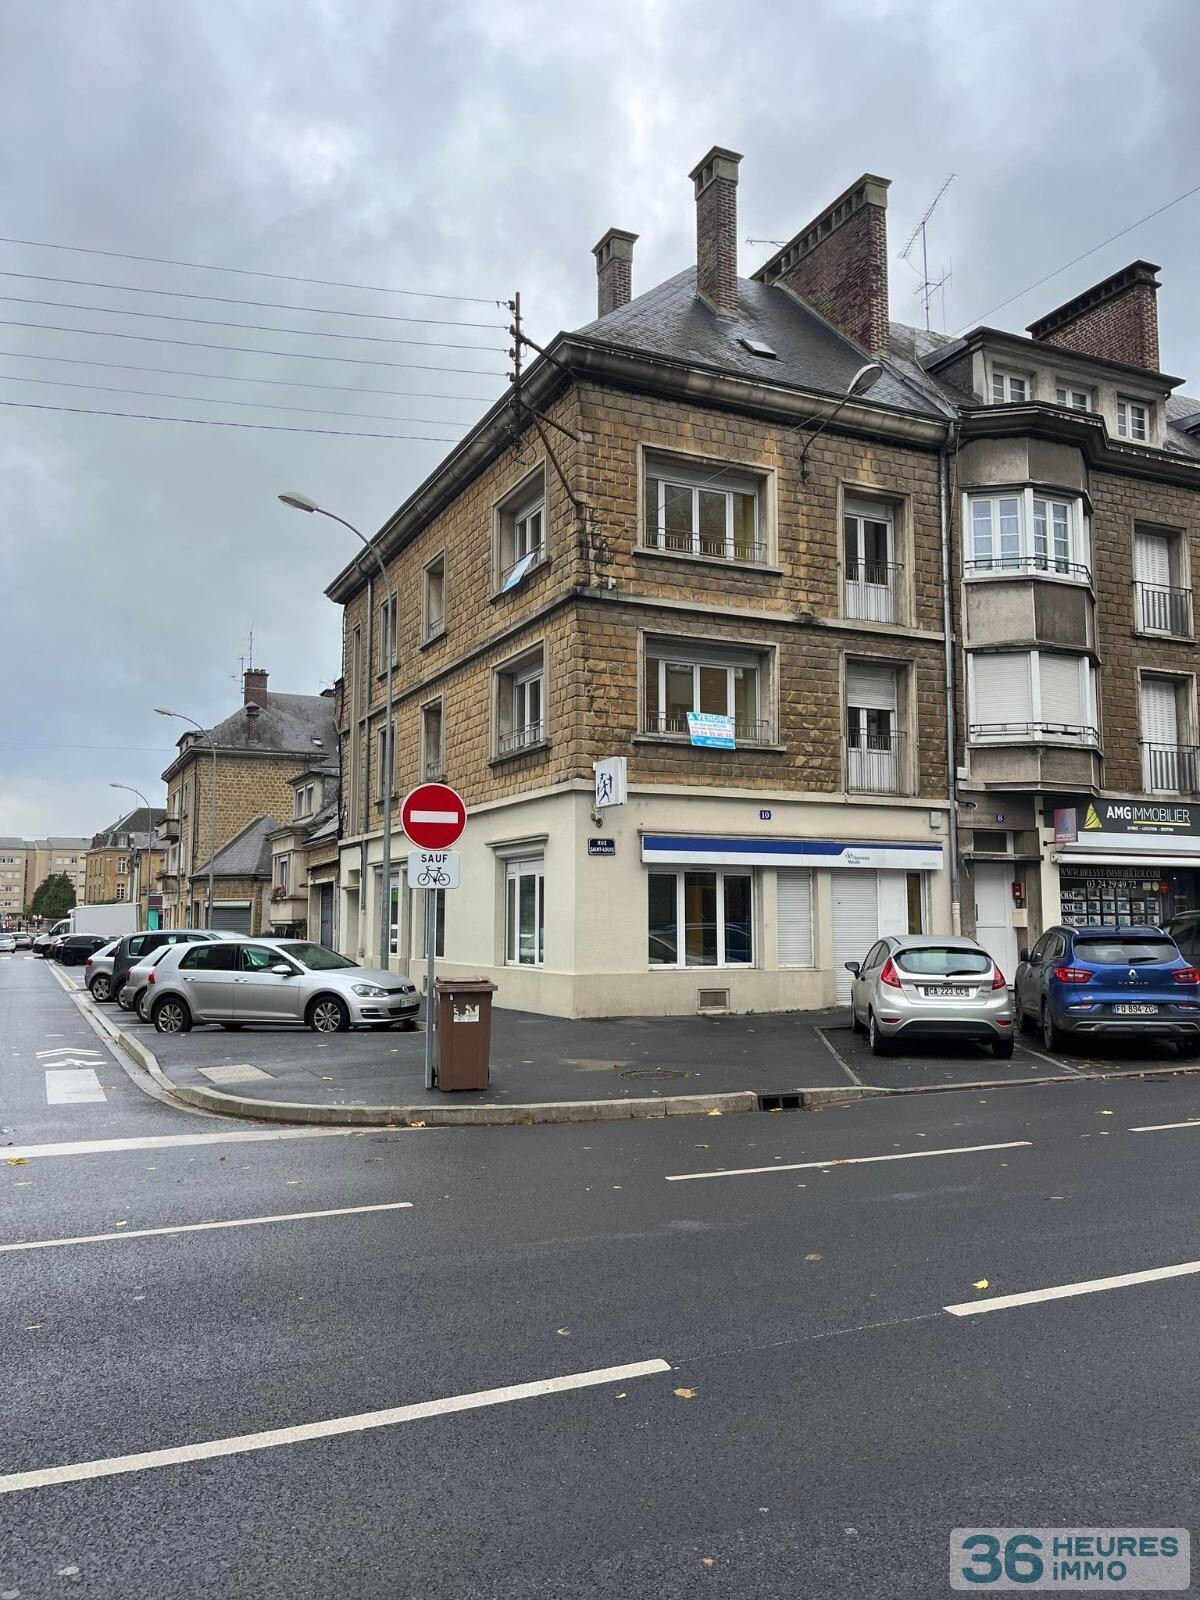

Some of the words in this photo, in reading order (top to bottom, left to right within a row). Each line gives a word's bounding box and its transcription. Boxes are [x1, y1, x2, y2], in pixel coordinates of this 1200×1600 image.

[761, 811, 770, 819] 10
[997, 814, 1003, 822] 8
[421, 854, 448, 863] SAUF
[1086, 880, 1095, 889] 03
[1098, 880, 1106, 889] 24
[1108, 881, 1116, 889] 29
[1118, 881, 1127, 889] 49
[1128, 881, 1137, 889] 72
